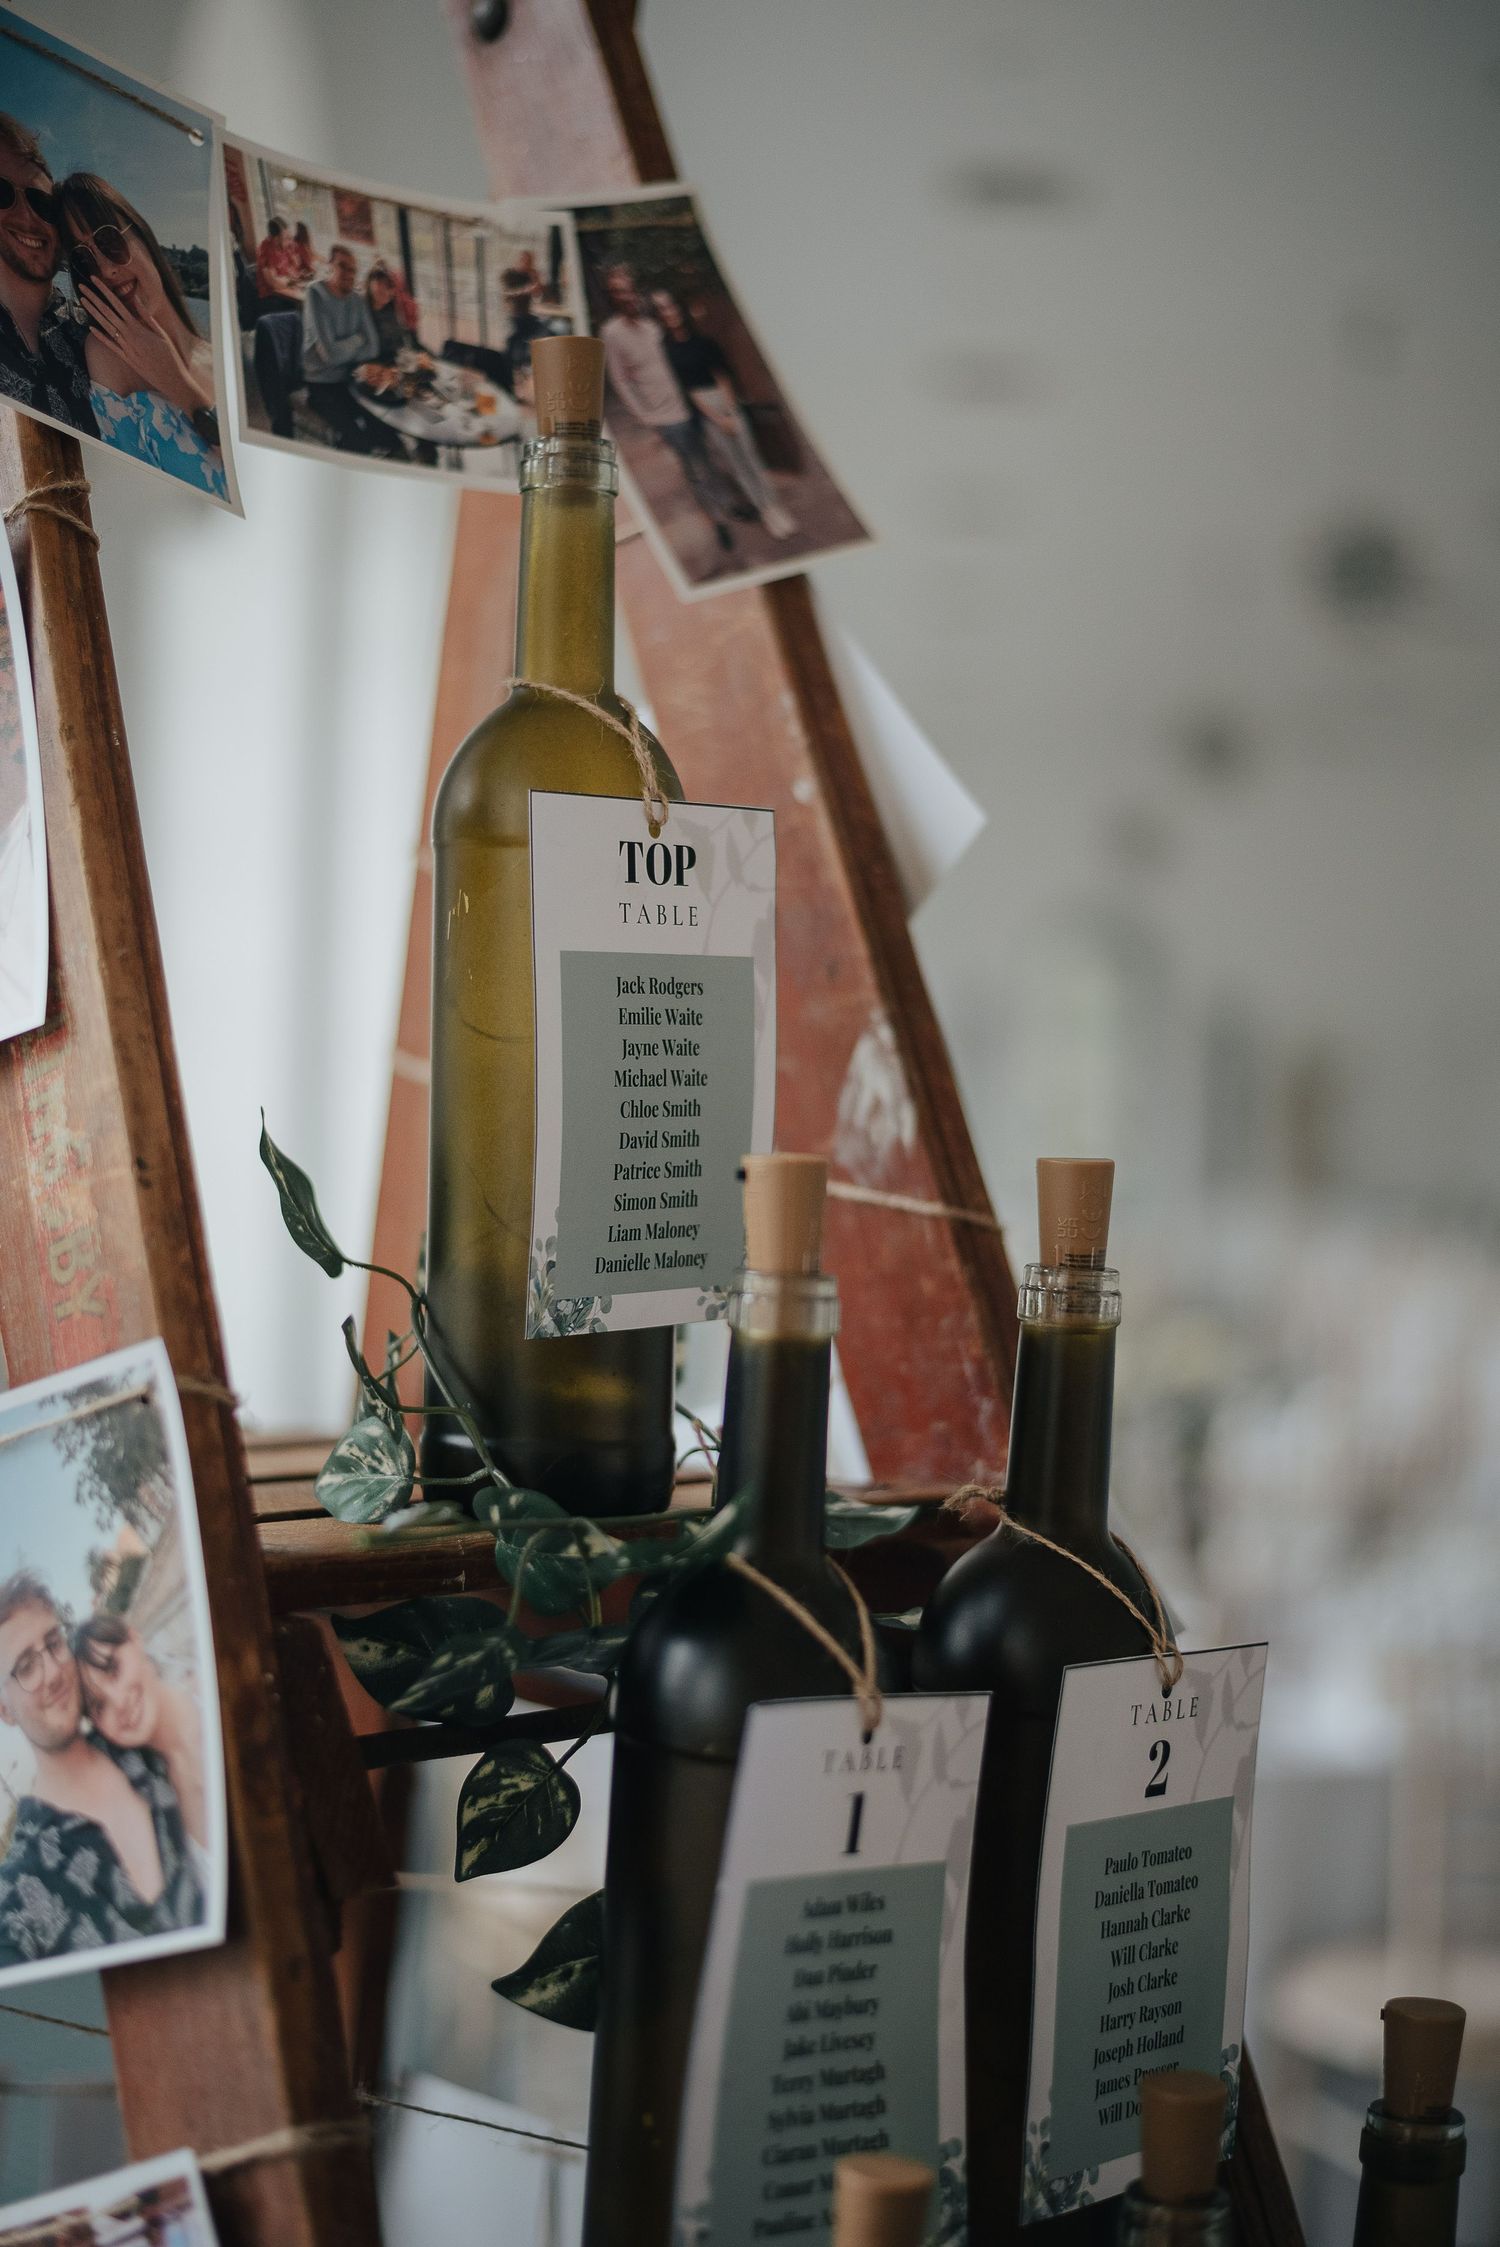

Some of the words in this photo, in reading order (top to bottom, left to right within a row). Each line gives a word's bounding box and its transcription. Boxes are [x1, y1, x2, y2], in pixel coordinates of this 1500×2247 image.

[619, 840, 697, 887] TOP
[619, 902, 698, 927] TABLE
[616, 975, 646, 998] Jack
[649, 976, 704, 999] Rodgers
[619, 1006, 662, 1026] Emilie
[664, 1007, 703, 1026] Waite
[622, 1039, 659, 1060] Jayne
[662, 1038, 700, 1056] Waite
[614, 1068, 667, 1088] Michael
[670, 1068, 708, 1087] Waite
[620, 1099, 659, 1119] Chloe
[662, 1098, 701, 1118] Smith
[619, 1130, 658, 1150] David
[661, 1129, 700, 1148] Smith
[613, 1161, 661, 1181] Patrice
[663, 1159, 702, 1179] Smith
[613, 1192, 656, 1212] Simon
[659, 1189, 698, 1209] Smith
[608, 1223, 641, 1243] Liam
[645, 1220, 700, 1241] Maloney
[595, 1252, 651, 1274] Danielle
[654, 1250, 708, 1270] Maloney
[1131, 1697, 1199, 1726] TABLE
[824, 1748, 905, 1774] TABLE
[1144, 1739, 1171, 1798] 2
[1104, 1852, 1139, 1876] Paulo
[1141, 1845, 1193, 1868] Tomateo
[1094, 1881, 1145, 1909] Daniella
[1147, 1875, 1199, 1898] Tomateo
[1101, 1911, 1149, 1940] Hannah
[1151, 1904, 1191, 1928] Clarke
[1111, 1944, 1136, 1968] Will
[1138, 1937, 1179, 1962] Clarke
[1107, 1976, 1135, 2004] Josh
[1137, 1968, 1178, 1993] Clarke
[1100, 2011, 1136, 2033] Harry
[1139, 2000, 1182, 2024] Rayson
[1093, 2038, 1134, 2070] Joseph
[1136, 2024, 1185, 2055] Holland
[1094, 2074, 1131, 2101] James
[1098, 2102, 1123, 2126] Will
